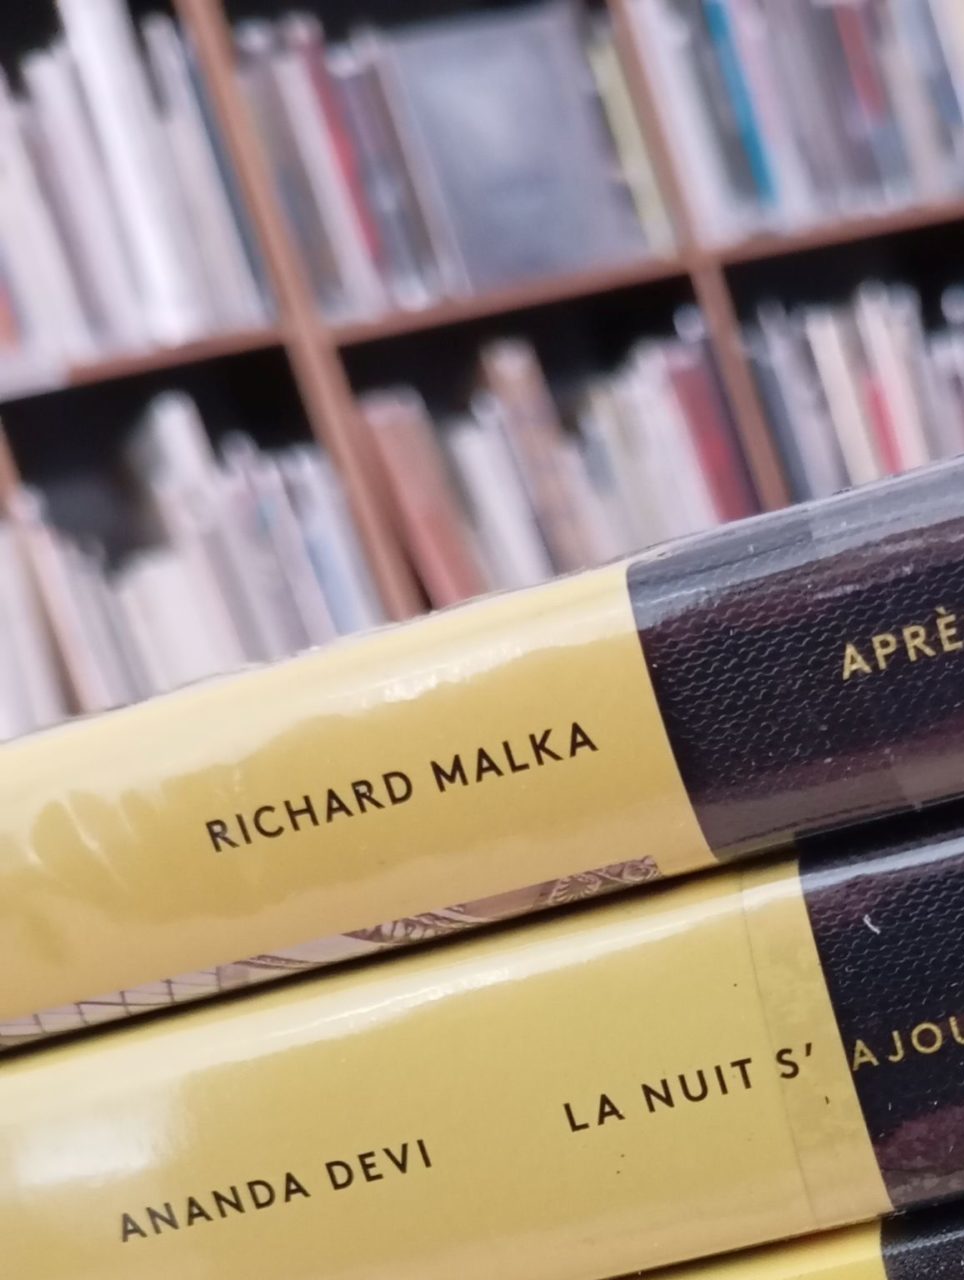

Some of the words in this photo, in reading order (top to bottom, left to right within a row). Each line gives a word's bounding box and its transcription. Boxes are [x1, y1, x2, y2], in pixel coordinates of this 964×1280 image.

[205, 770, 414, 853] RICHARD
[430, 721, 599, 793] MALKA
[563, 1093, 626, 1133] LA
[642, 1058, 755, 1114] NUIT
[776, 1042, 814, 1078] S'
[118, 1171, 312, 1243] ANANDA
[324, 1138, 433, 1191] DEVI
